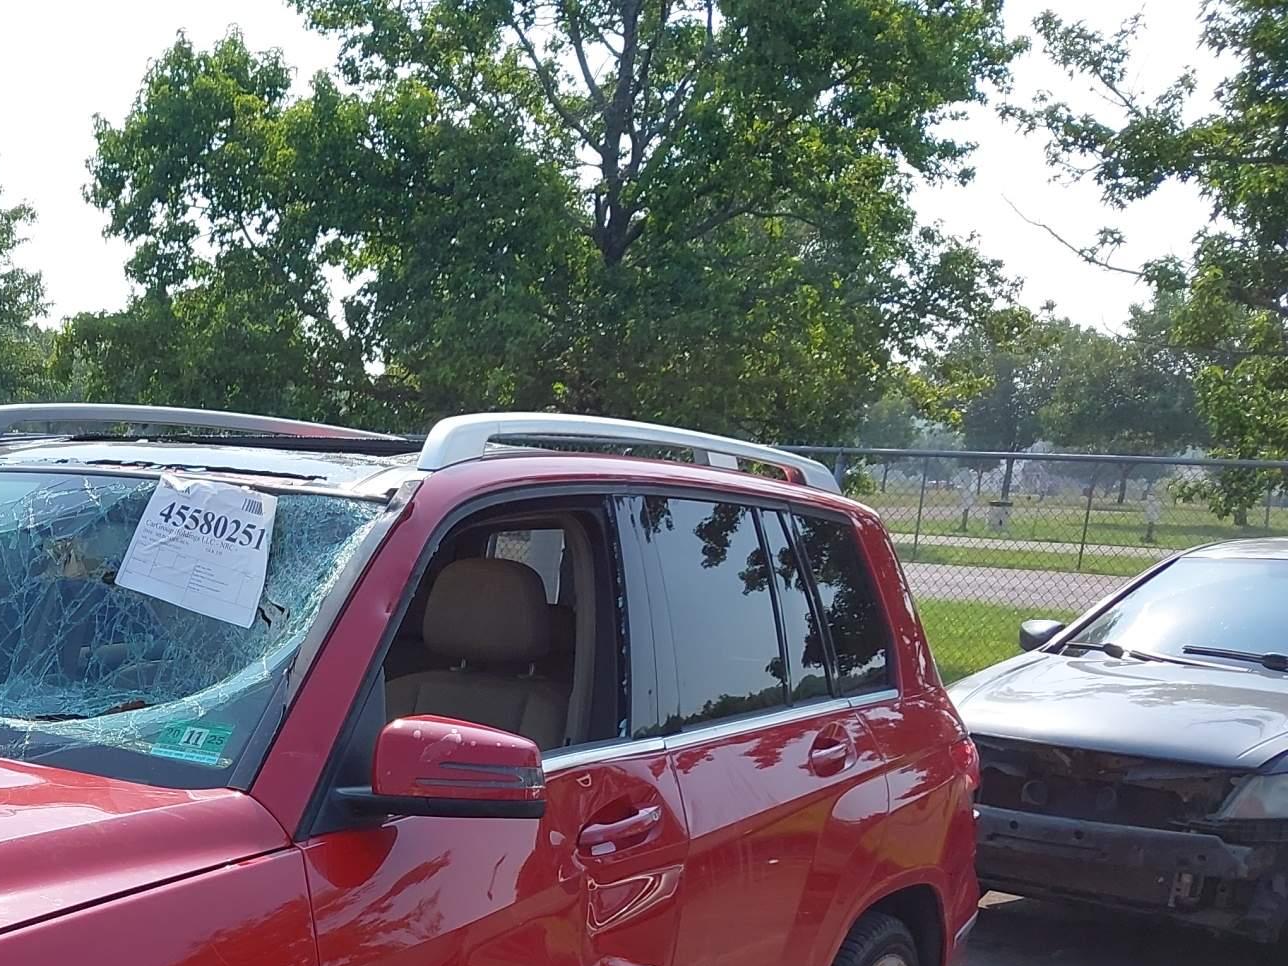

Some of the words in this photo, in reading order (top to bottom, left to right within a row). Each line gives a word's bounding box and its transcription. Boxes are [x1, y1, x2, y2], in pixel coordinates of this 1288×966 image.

[159, 501, 267, 550] 45580251
[167, 727, 181, 738] 20
[183, 729, 204, 746] 11
[207, 735, 225, 746] 25
